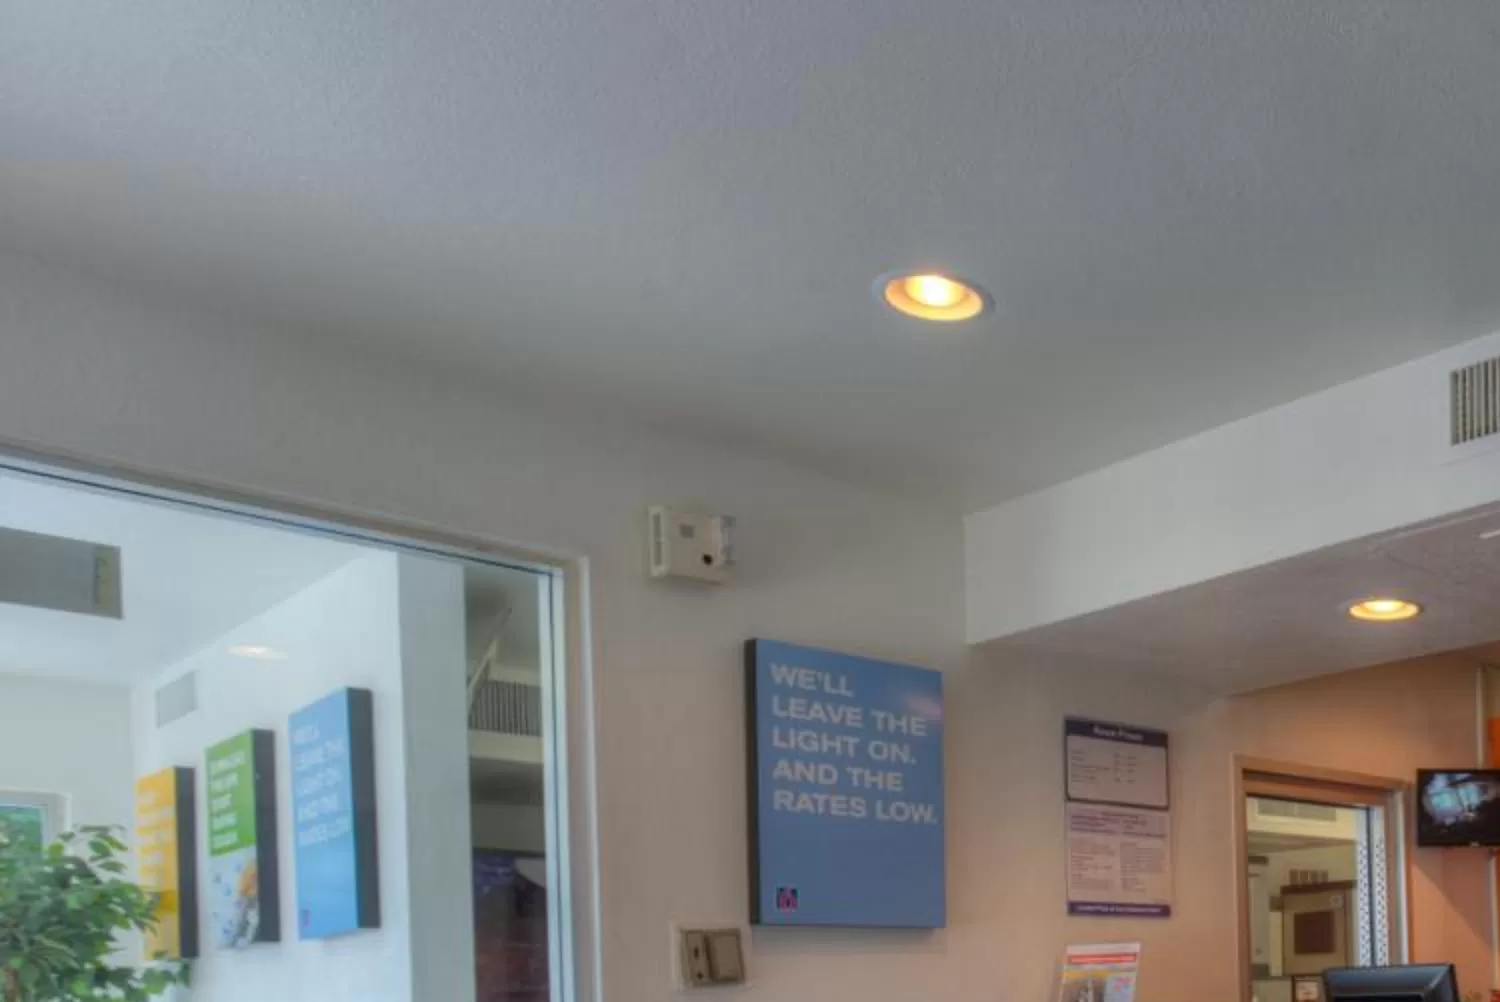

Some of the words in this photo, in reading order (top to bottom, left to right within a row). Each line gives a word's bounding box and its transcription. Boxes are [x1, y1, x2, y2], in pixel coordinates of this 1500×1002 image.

[770, 663, 853, 697] WE'LL
[772, 694, 864, 728] LEAVE
[870, 709, 928, 737] THE
[772, 726, 860, 758] LIGHT
[868, 740, 917, 765] ON.
[772, 759, 838, 785] AND
[846, 767, 904, 792] THE
[773, 789, 866, 819] RATES
[875, 800, 938, 825] LOW.
